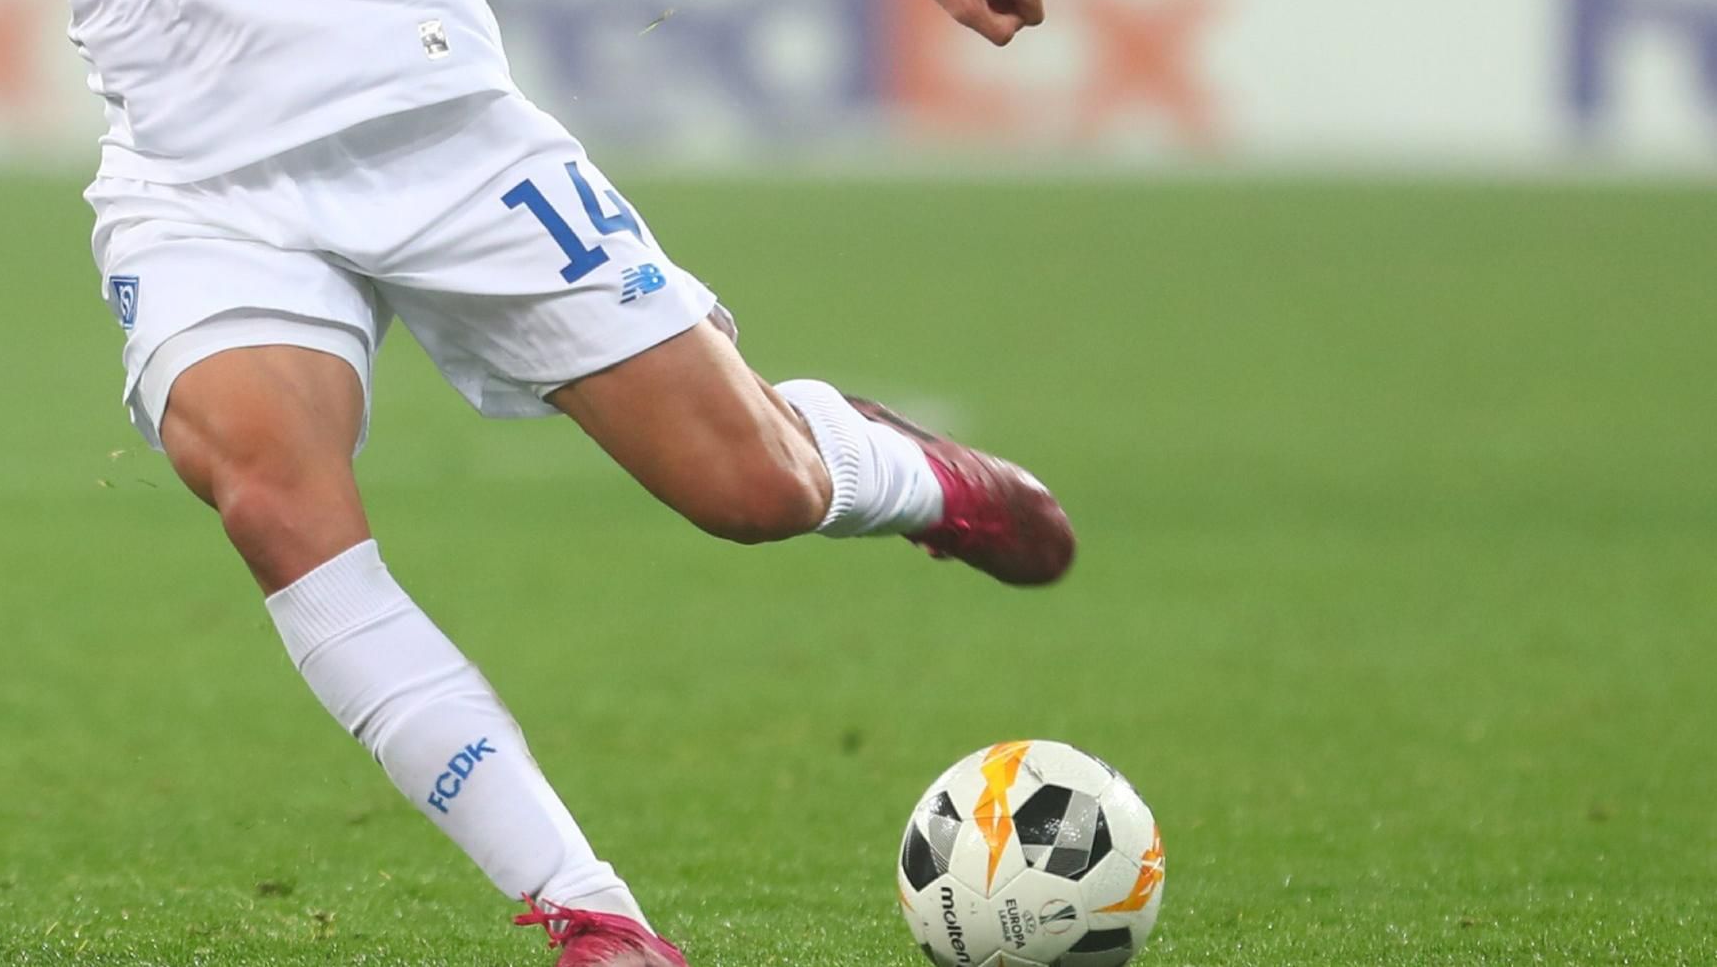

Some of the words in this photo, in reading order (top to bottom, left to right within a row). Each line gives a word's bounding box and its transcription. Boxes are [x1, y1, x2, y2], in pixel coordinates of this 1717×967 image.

[501, 161, 649, 284] 14
[427, 737, 497, 813] FCDK
[940, 886, 971, 963] molten
[1005, 899, 1026, 950] EUROPA
